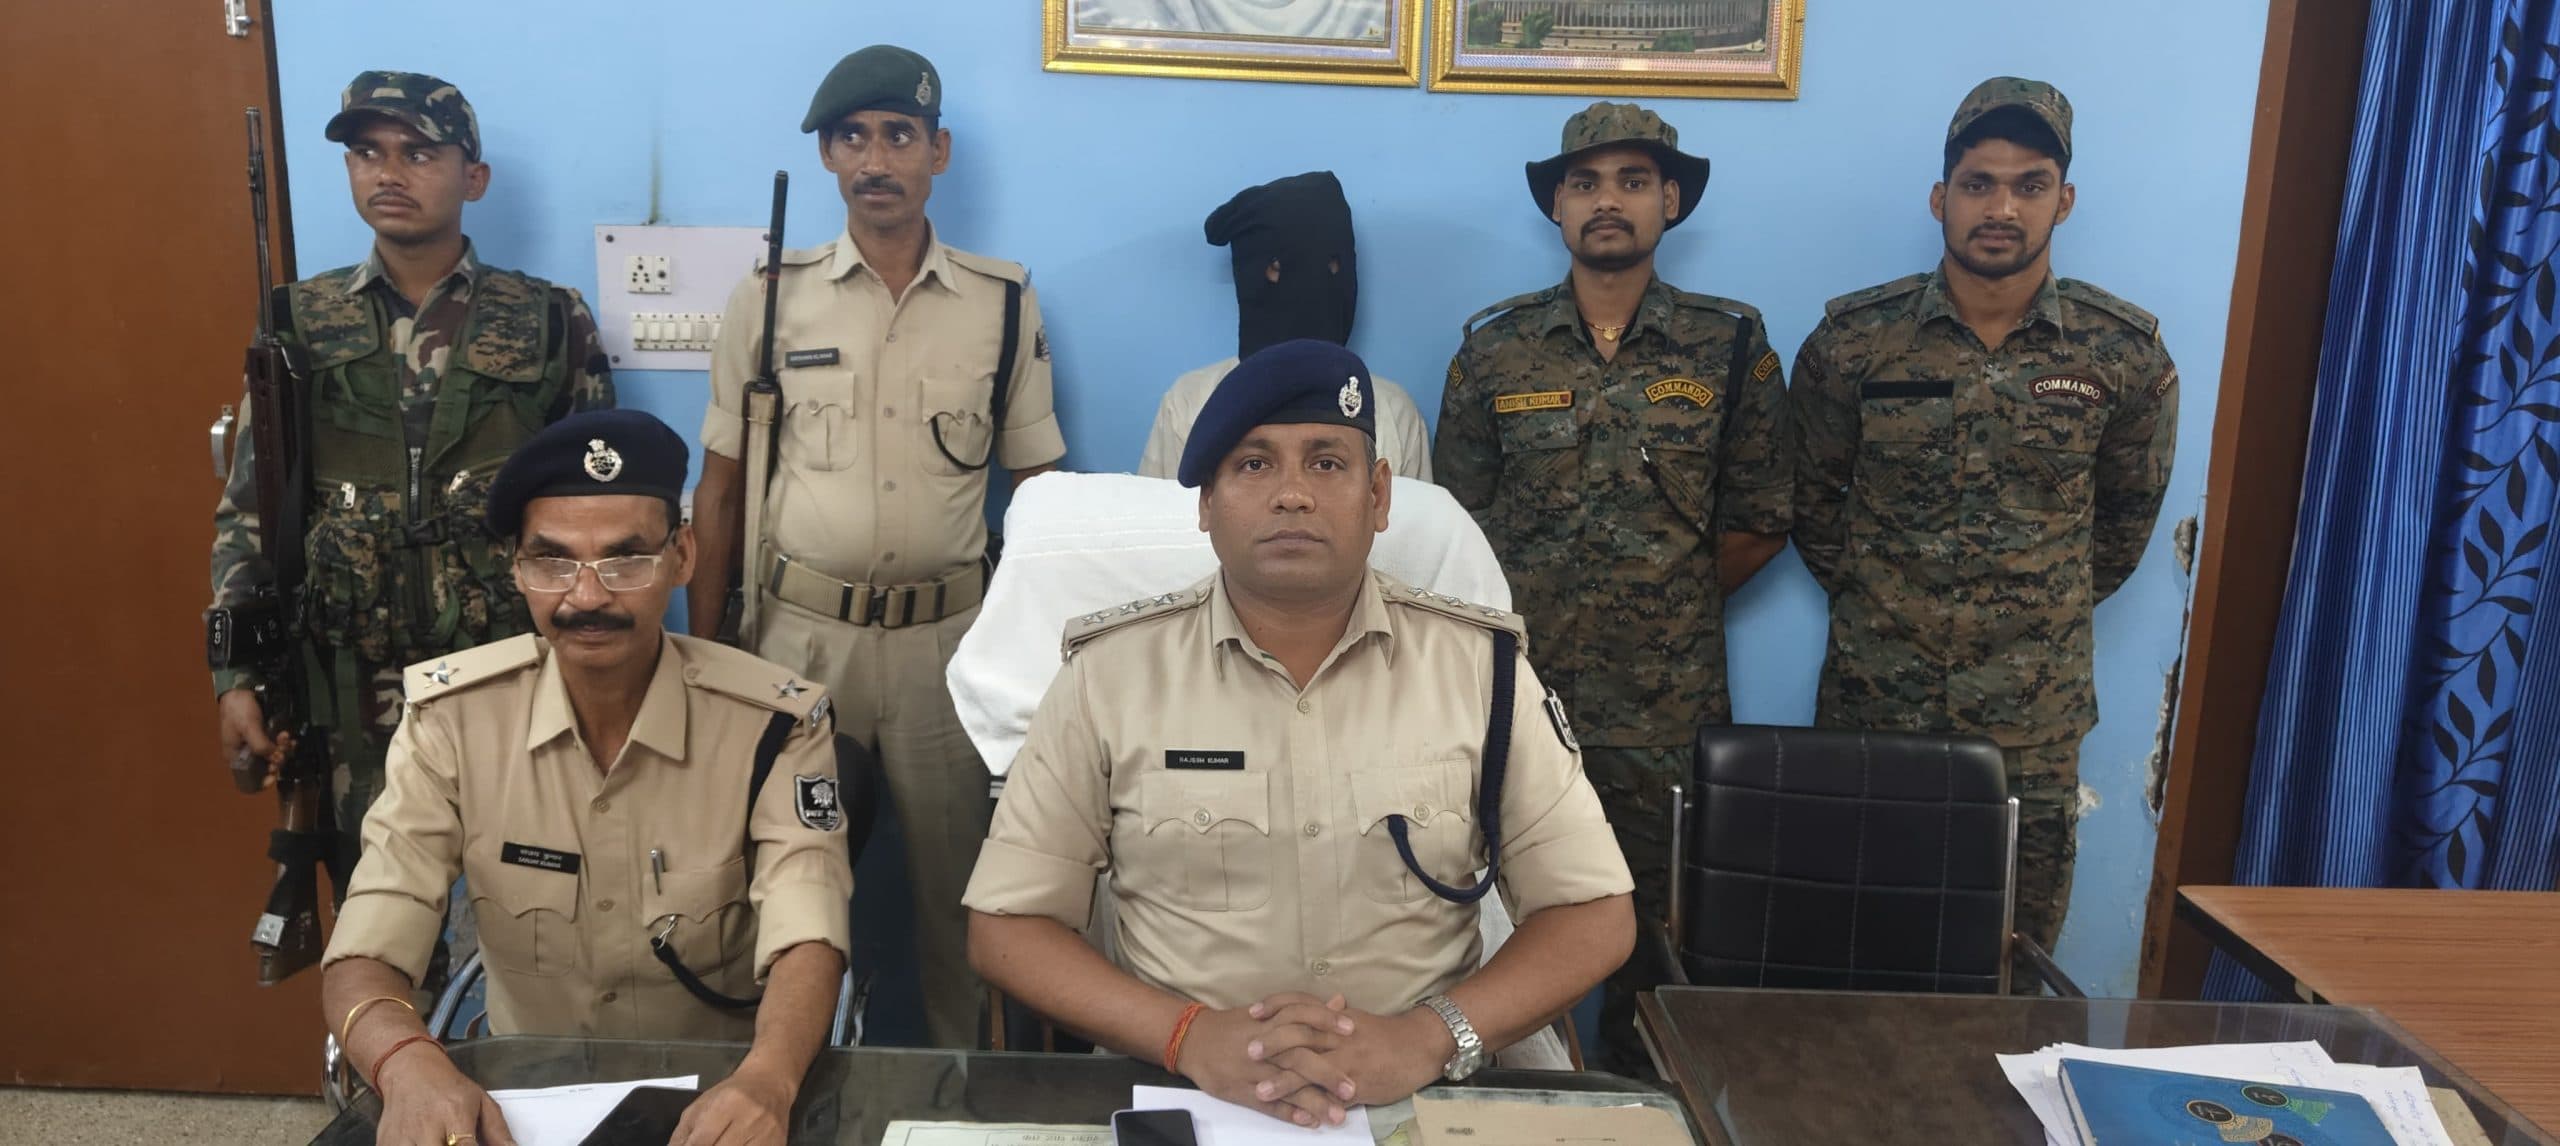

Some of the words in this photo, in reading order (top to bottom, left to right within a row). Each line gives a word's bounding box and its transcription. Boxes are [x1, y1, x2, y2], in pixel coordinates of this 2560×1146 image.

[1650, 382, 1707, 401] COMMANDO
[2035, 379, 2101, 400] COMMANDO
[1529, 394, 1561, 407] KUMAR
